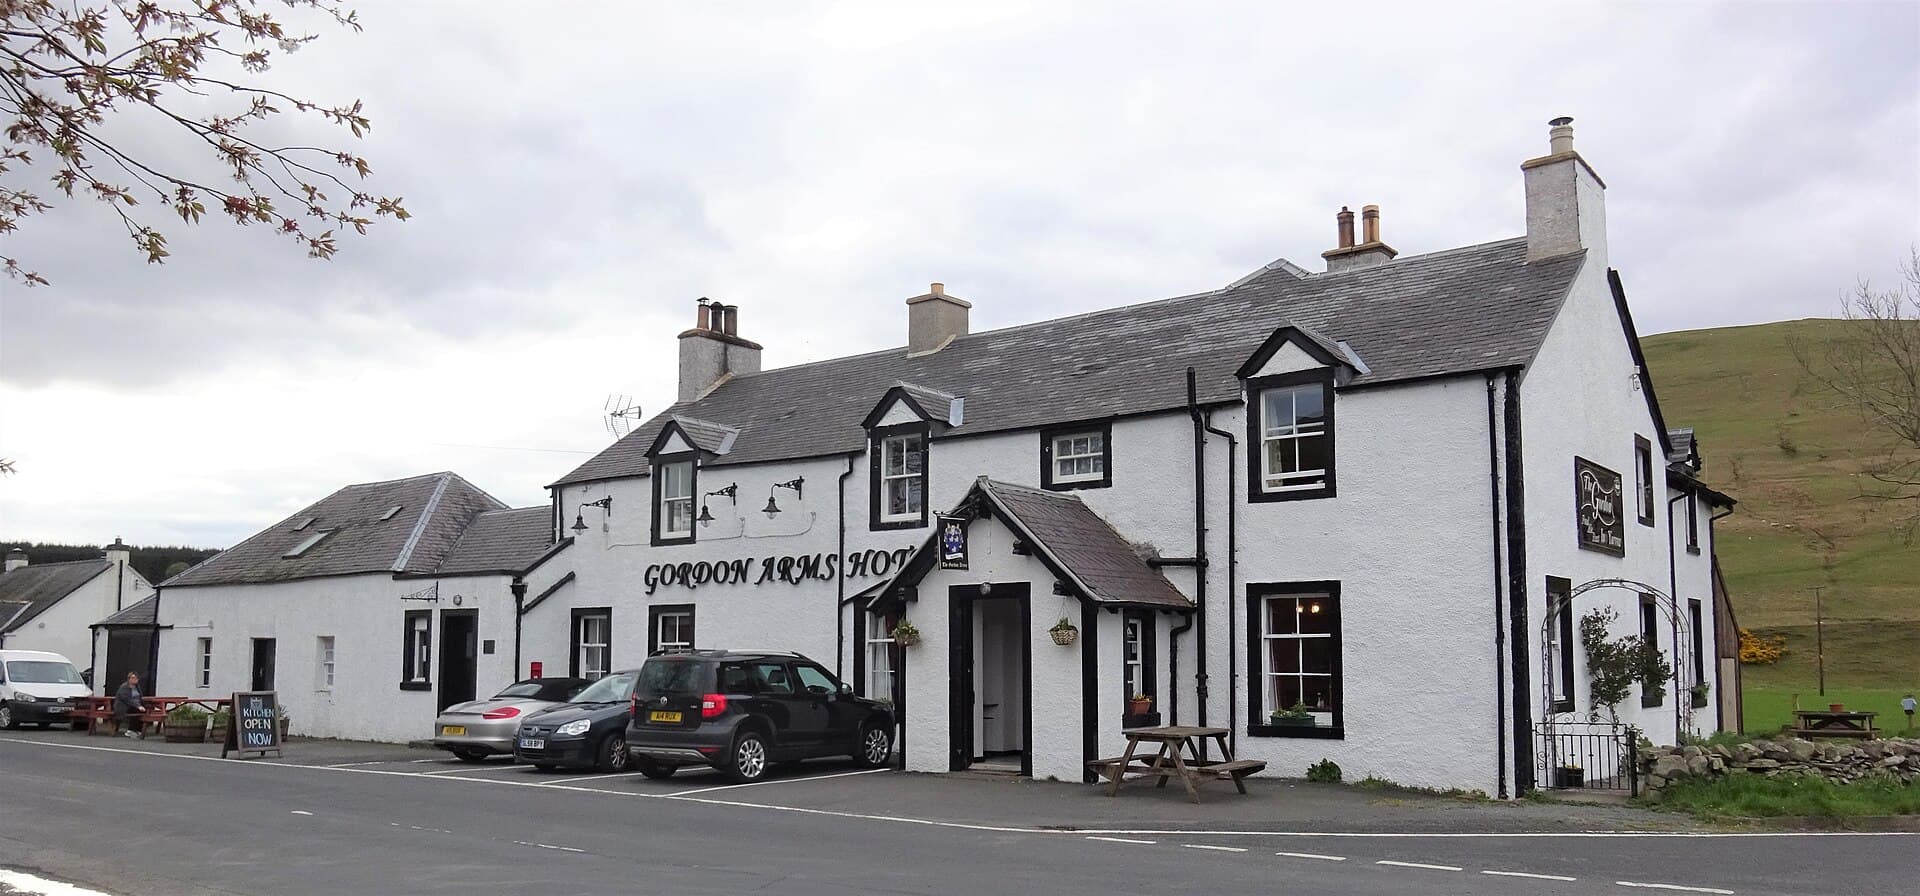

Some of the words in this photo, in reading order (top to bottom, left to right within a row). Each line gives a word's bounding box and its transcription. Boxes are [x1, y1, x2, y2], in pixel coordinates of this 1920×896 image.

[644, 557, 754, 595] GORDON
[754, 553, 838, 586] ARMS
[846, 545, 917, 578] HOT
[243, 707, 274, 717] KITCHEN
[244, 718, 271, 729] OPEN
[248, 732, 272, 745] NOW
